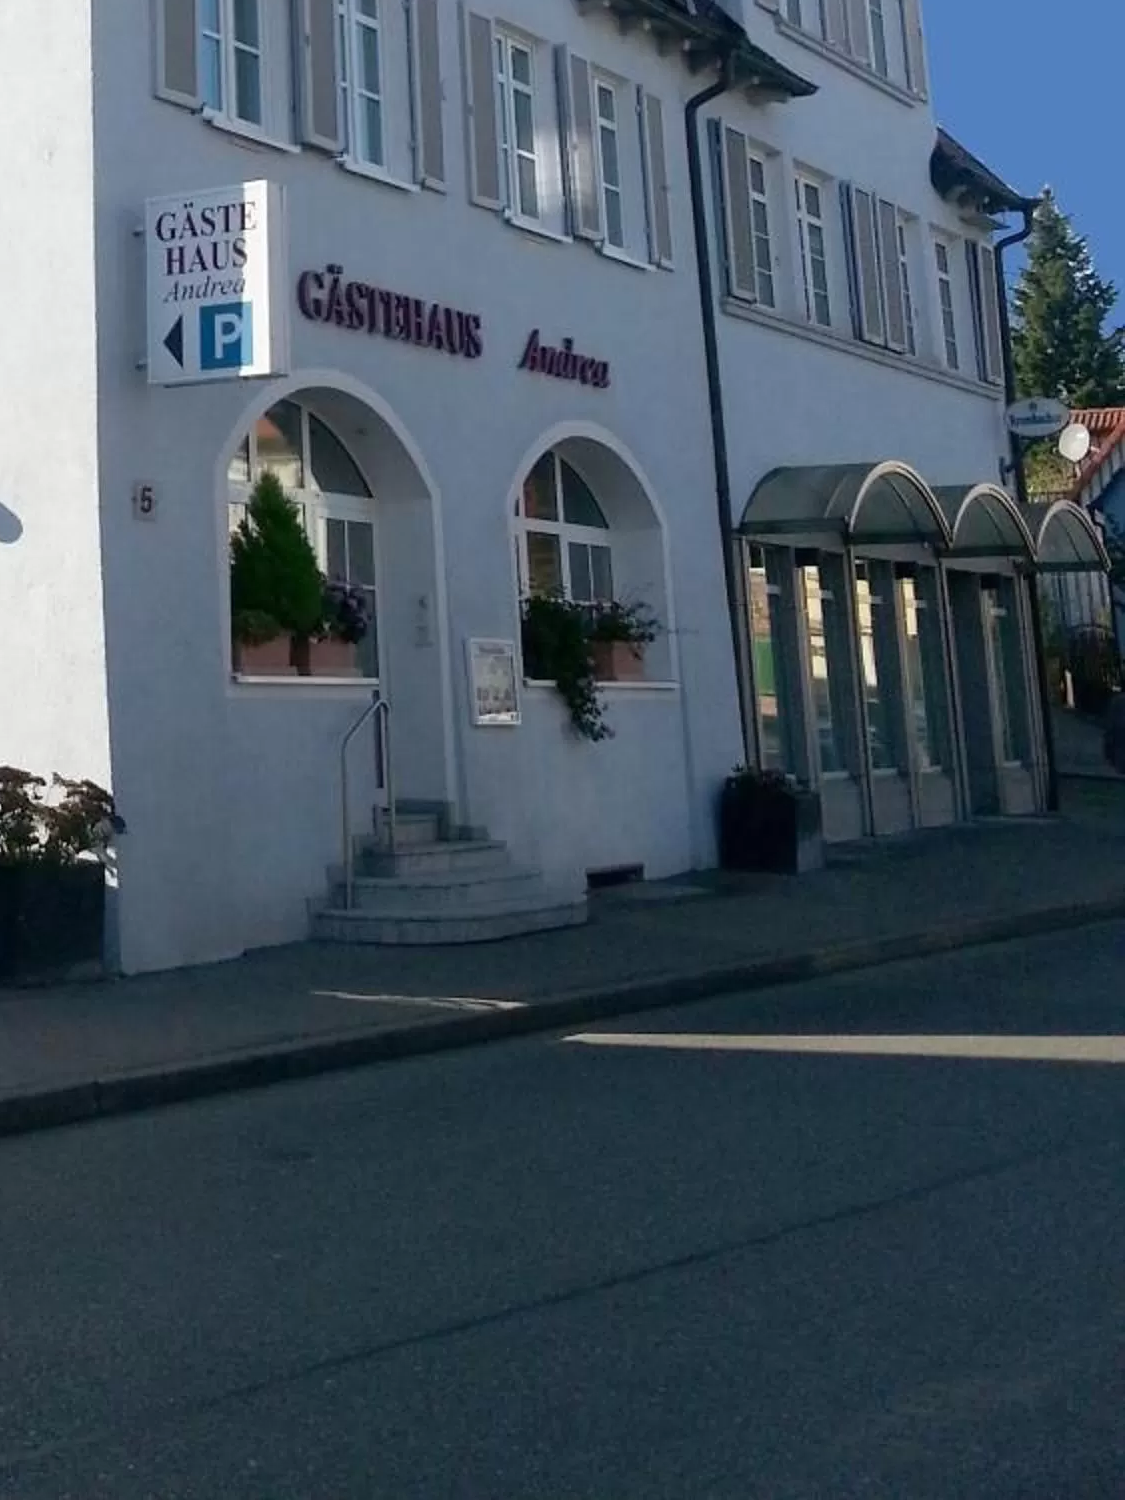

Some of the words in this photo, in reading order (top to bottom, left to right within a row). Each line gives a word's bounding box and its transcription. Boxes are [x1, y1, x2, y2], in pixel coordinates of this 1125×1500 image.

[156, 202, 257, 242] GÄSTE
[166, 238, 248, 276] HAUS
[163, 276, 246, 303] Andrea
[214, 312, 241, 360] P
[297, 264, 484, 359] GÄSTEHAUS
[518, 329, 611, 388] Andrea
[141, 487, 153, 513] 5
